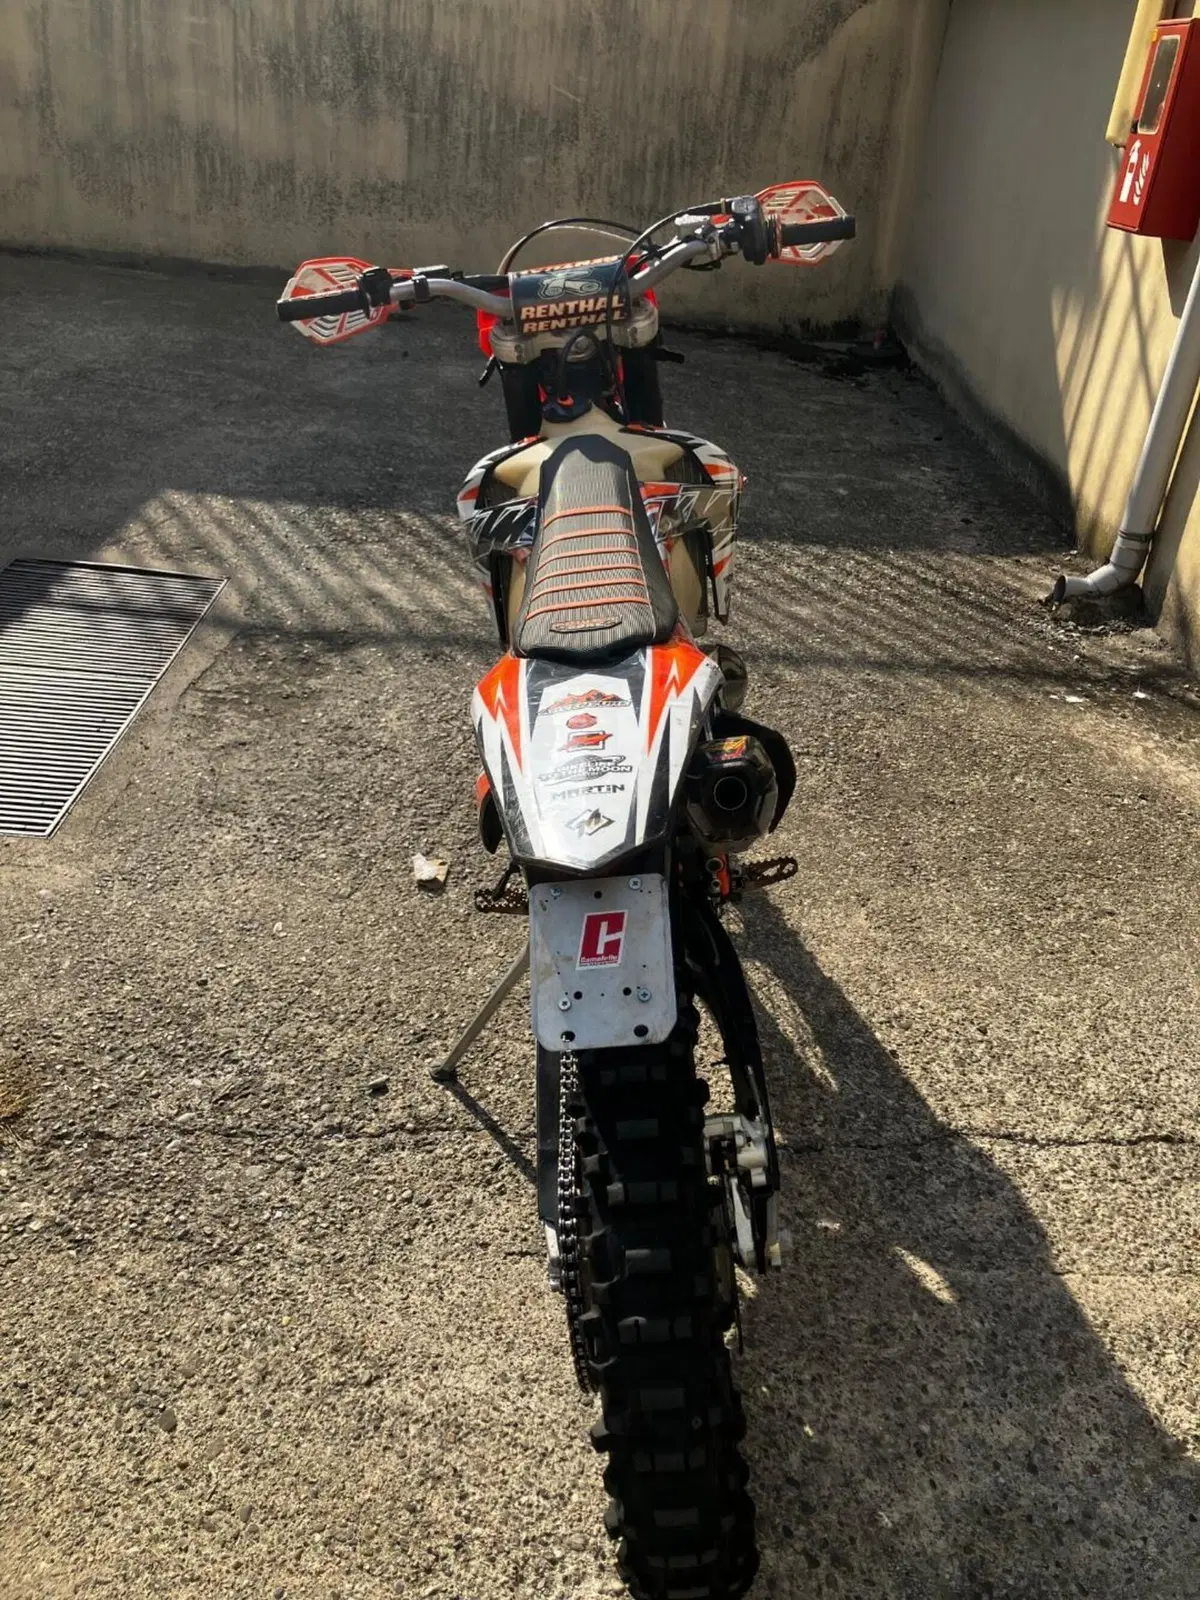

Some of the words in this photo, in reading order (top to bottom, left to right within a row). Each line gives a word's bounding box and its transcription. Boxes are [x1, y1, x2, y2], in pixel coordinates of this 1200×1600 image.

[521, 295, 624, 320] RENTHAL
[522, 311, 624, 333] RENTHAL
[588, 764, 632, 773] MOON
